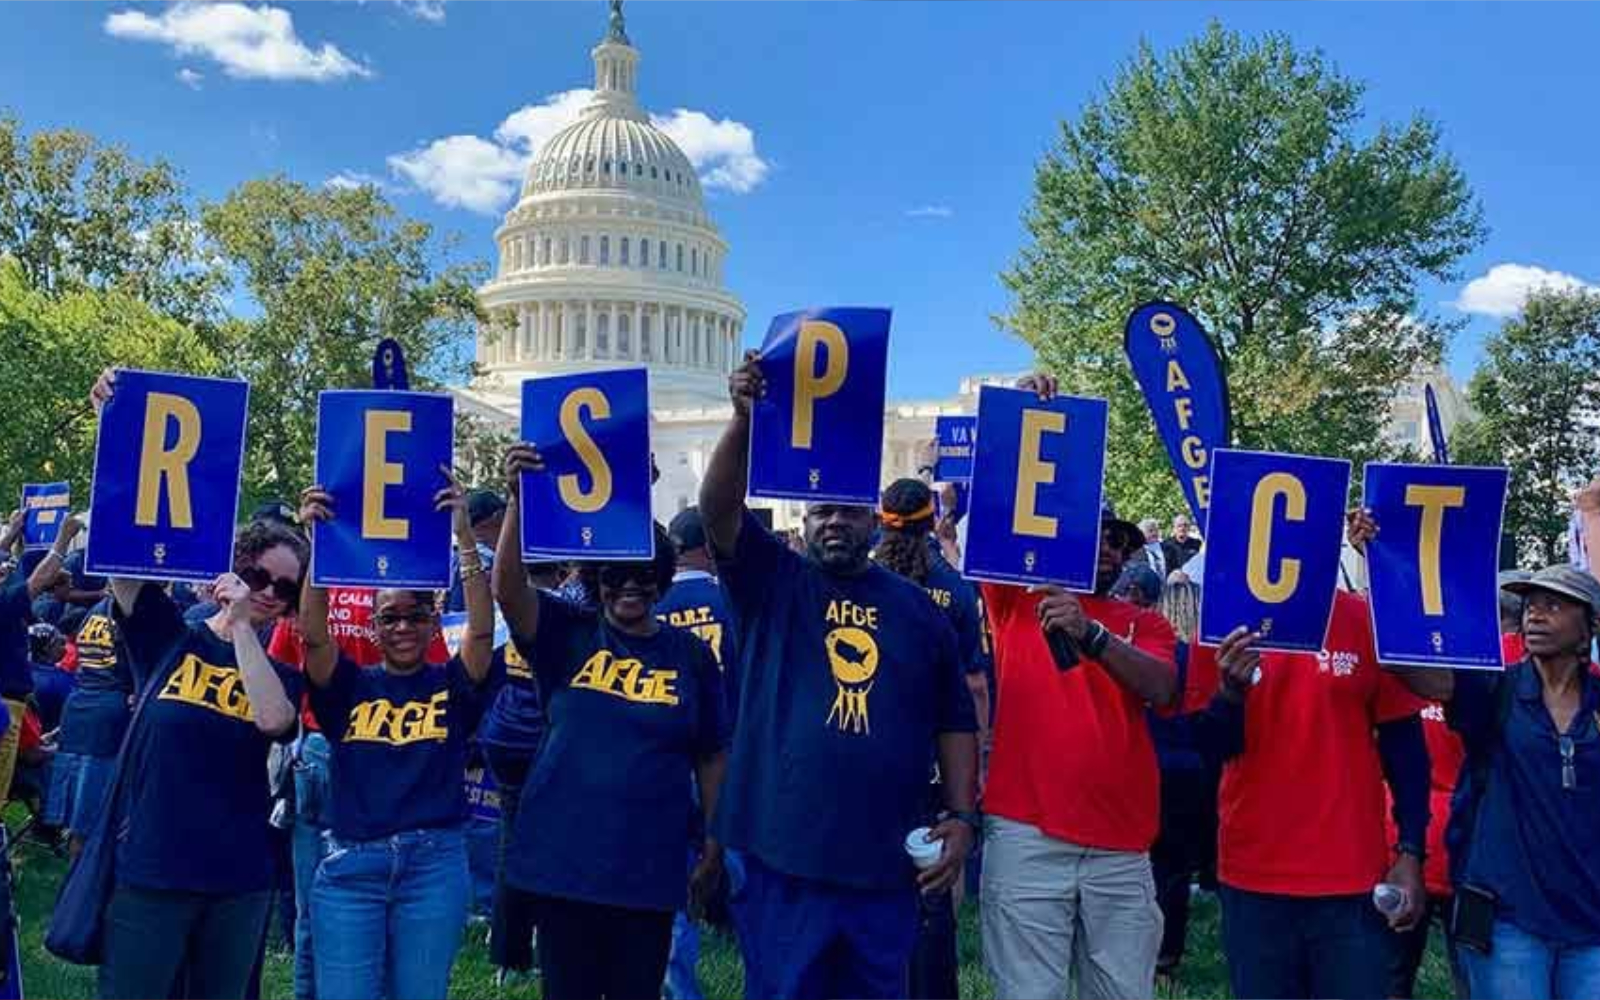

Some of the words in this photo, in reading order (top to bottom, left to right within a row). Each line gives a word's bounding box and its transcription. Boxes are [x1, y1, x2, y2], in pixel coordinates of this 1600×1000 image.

[791, 320, 849, 450] P
[1166, 360, 1210, 509] AFGE
[134, 392, 202, 529] R
[361, 409, 413, 540] E
[557, 387, 612, 514] S
[1012, 408, 1066, 539] E
[1246, 472, 1307, 604] C
[1405, 484, 1465, 617] T
[570, 649, 679, 705] AFGE
[825, 599, 878, 630] AFGE
[157, 653, 256, 722] AFG
[342, 690, 449, 745] AFGE
